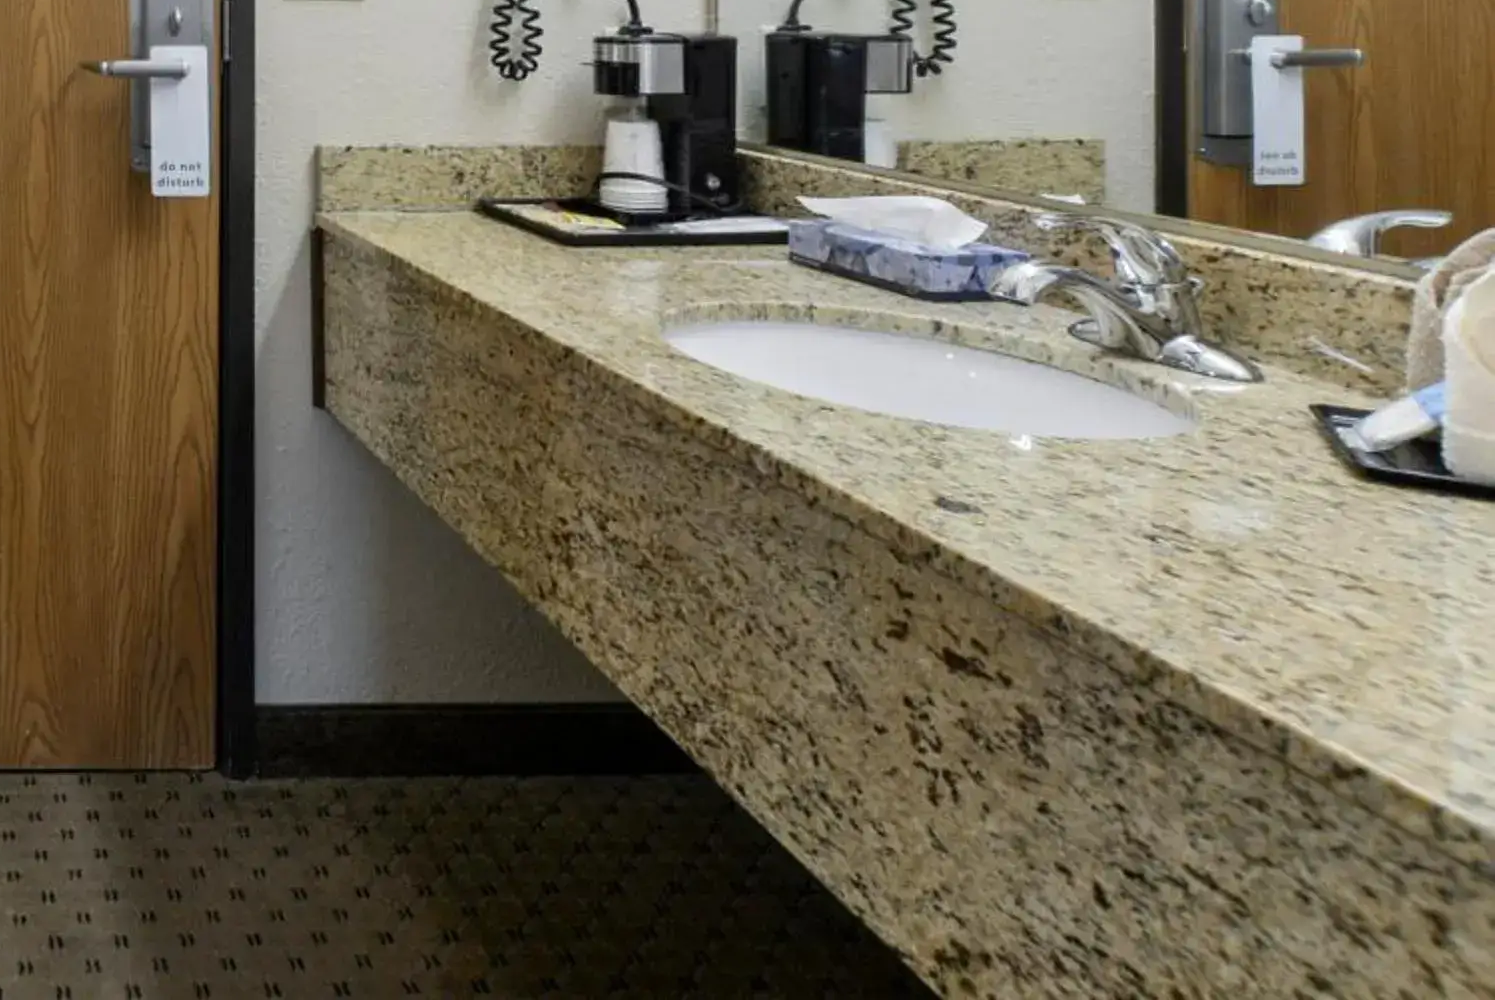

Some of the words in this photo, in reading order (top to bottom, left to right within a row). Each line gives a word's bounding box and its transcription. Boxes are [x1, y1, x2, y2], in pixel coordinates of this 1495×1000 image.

[160, 160, 176, 171] do
[180, 160, 202, 171] not
[157, 176, 204, 188] disturb
